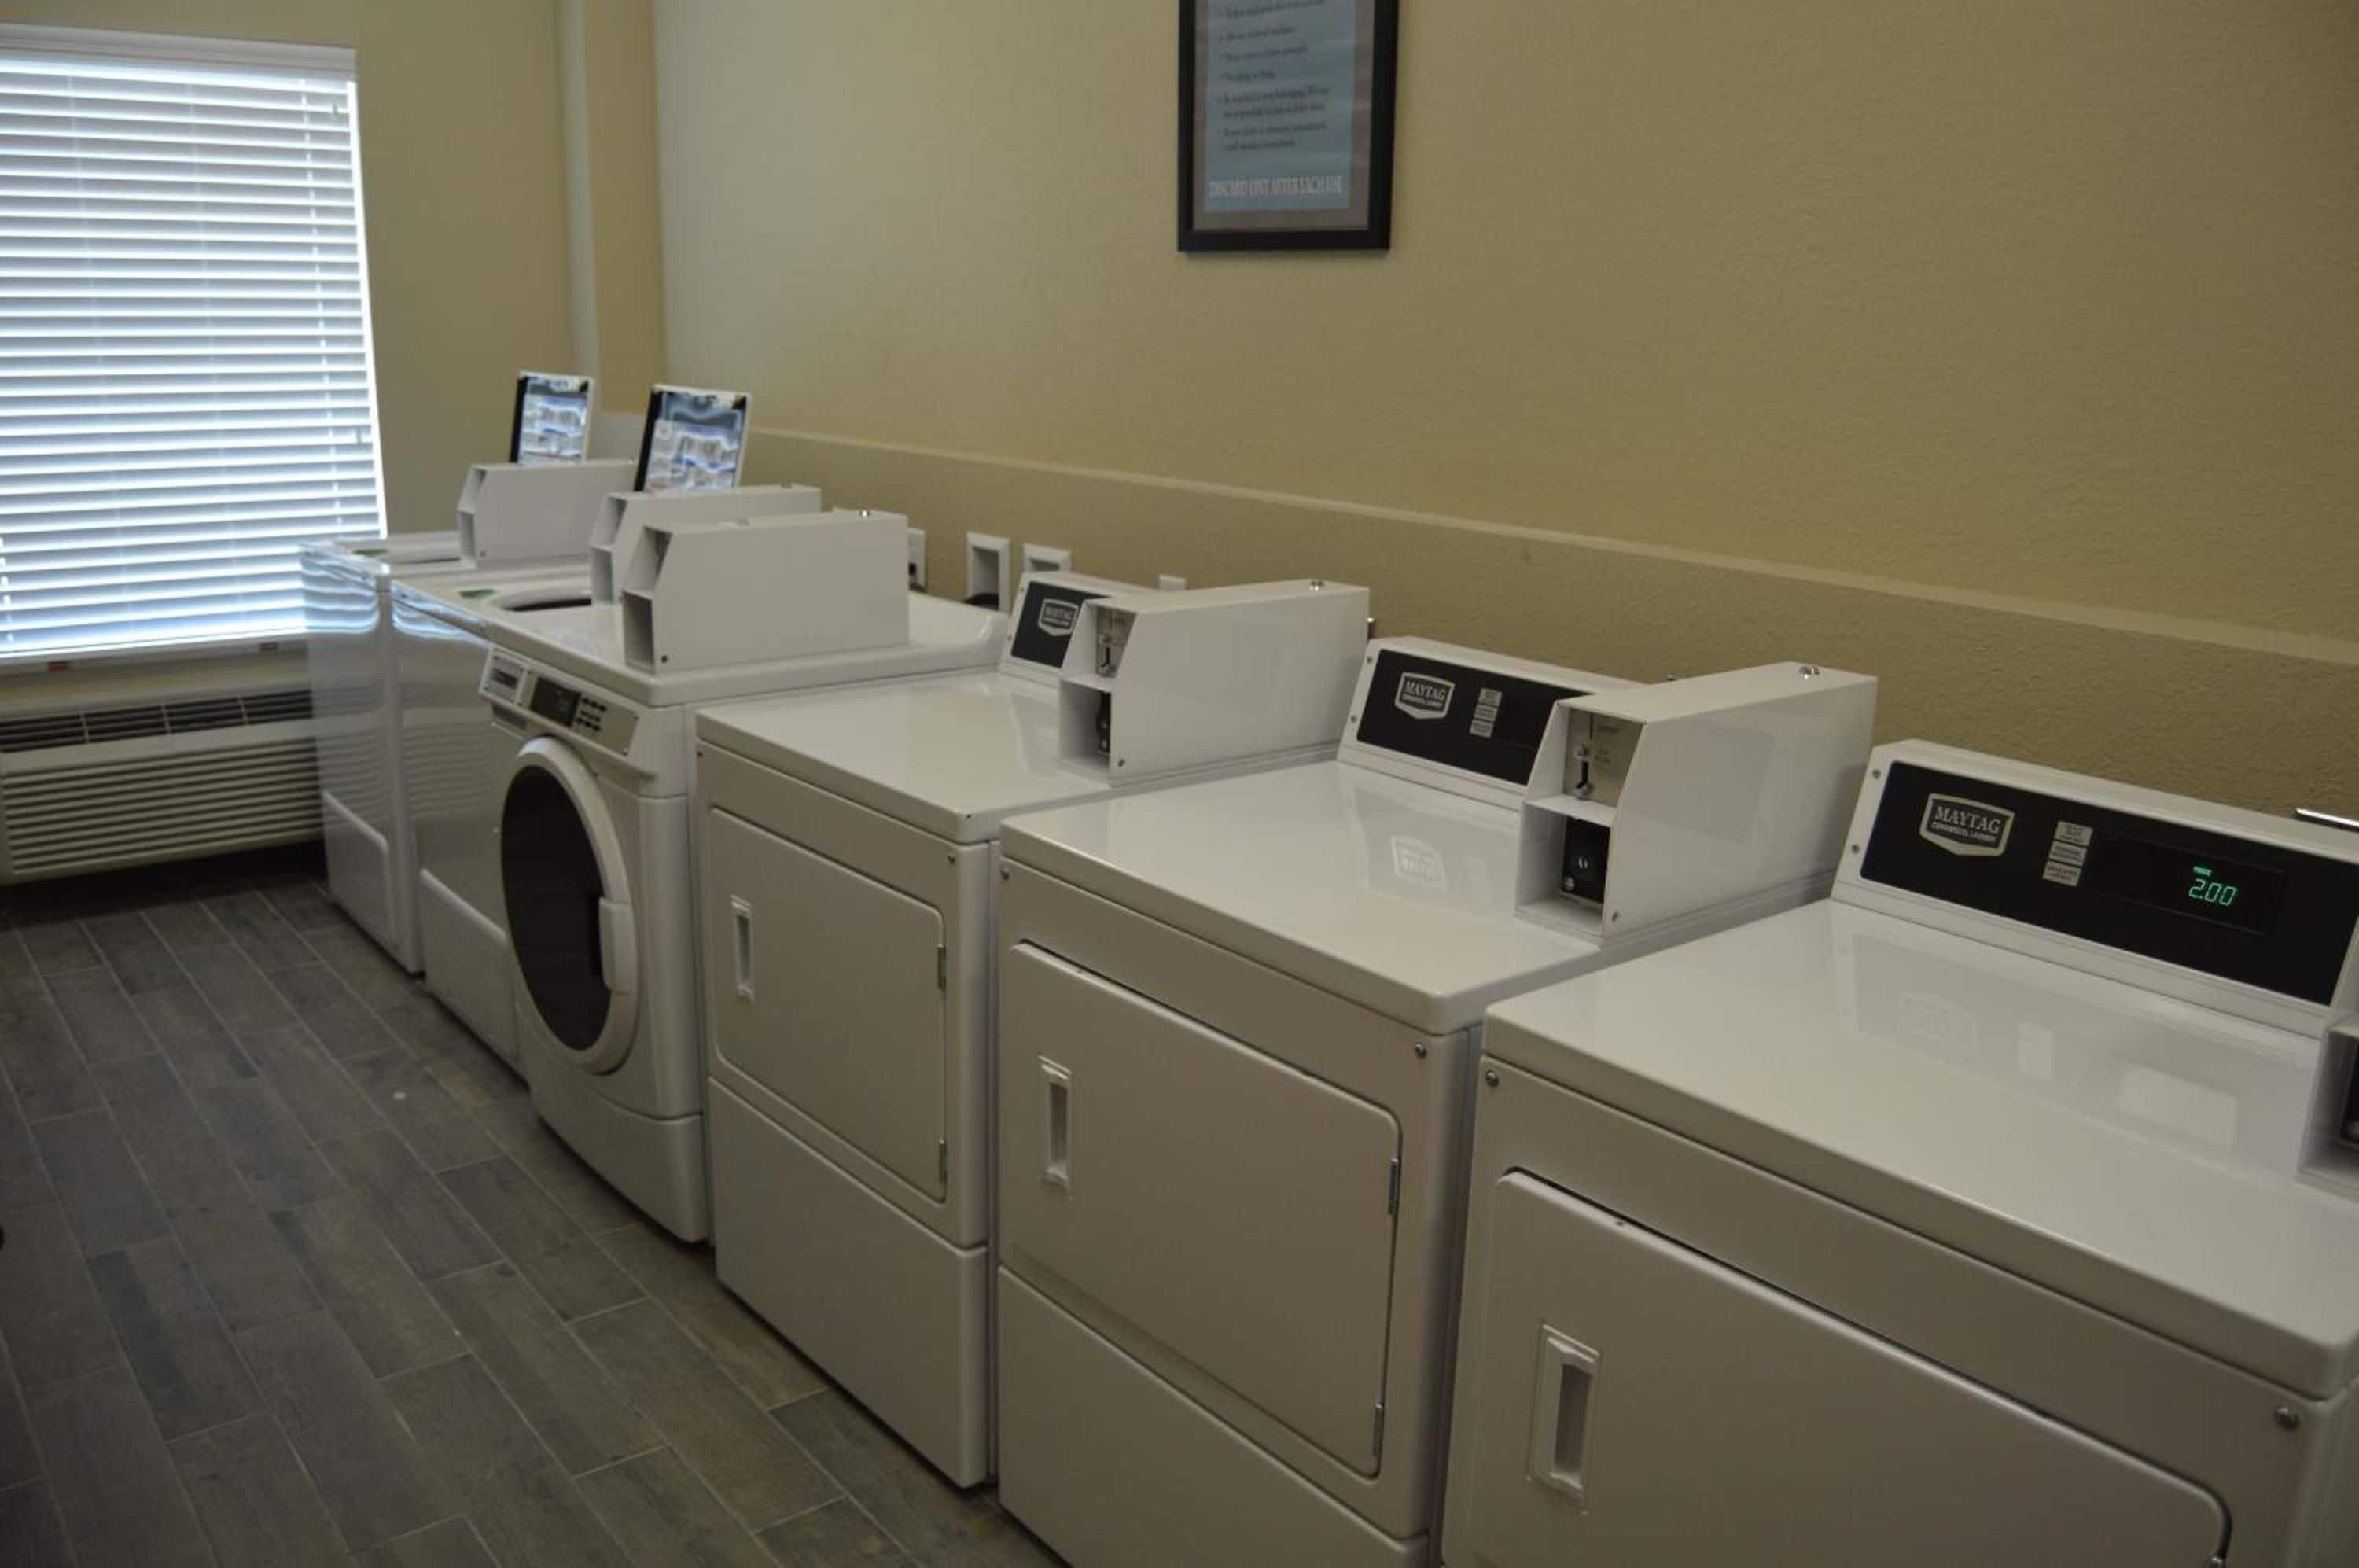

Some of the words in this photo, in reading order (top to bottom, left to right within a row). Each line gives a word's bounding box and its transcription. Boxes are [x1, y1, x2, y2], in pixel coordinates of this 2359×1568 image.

[1404, 680, 1447, 702] MAYTAG
[1935, 804, 2001, 834] MAYTAG
[2189, 878, 2238, 907] 2.00
